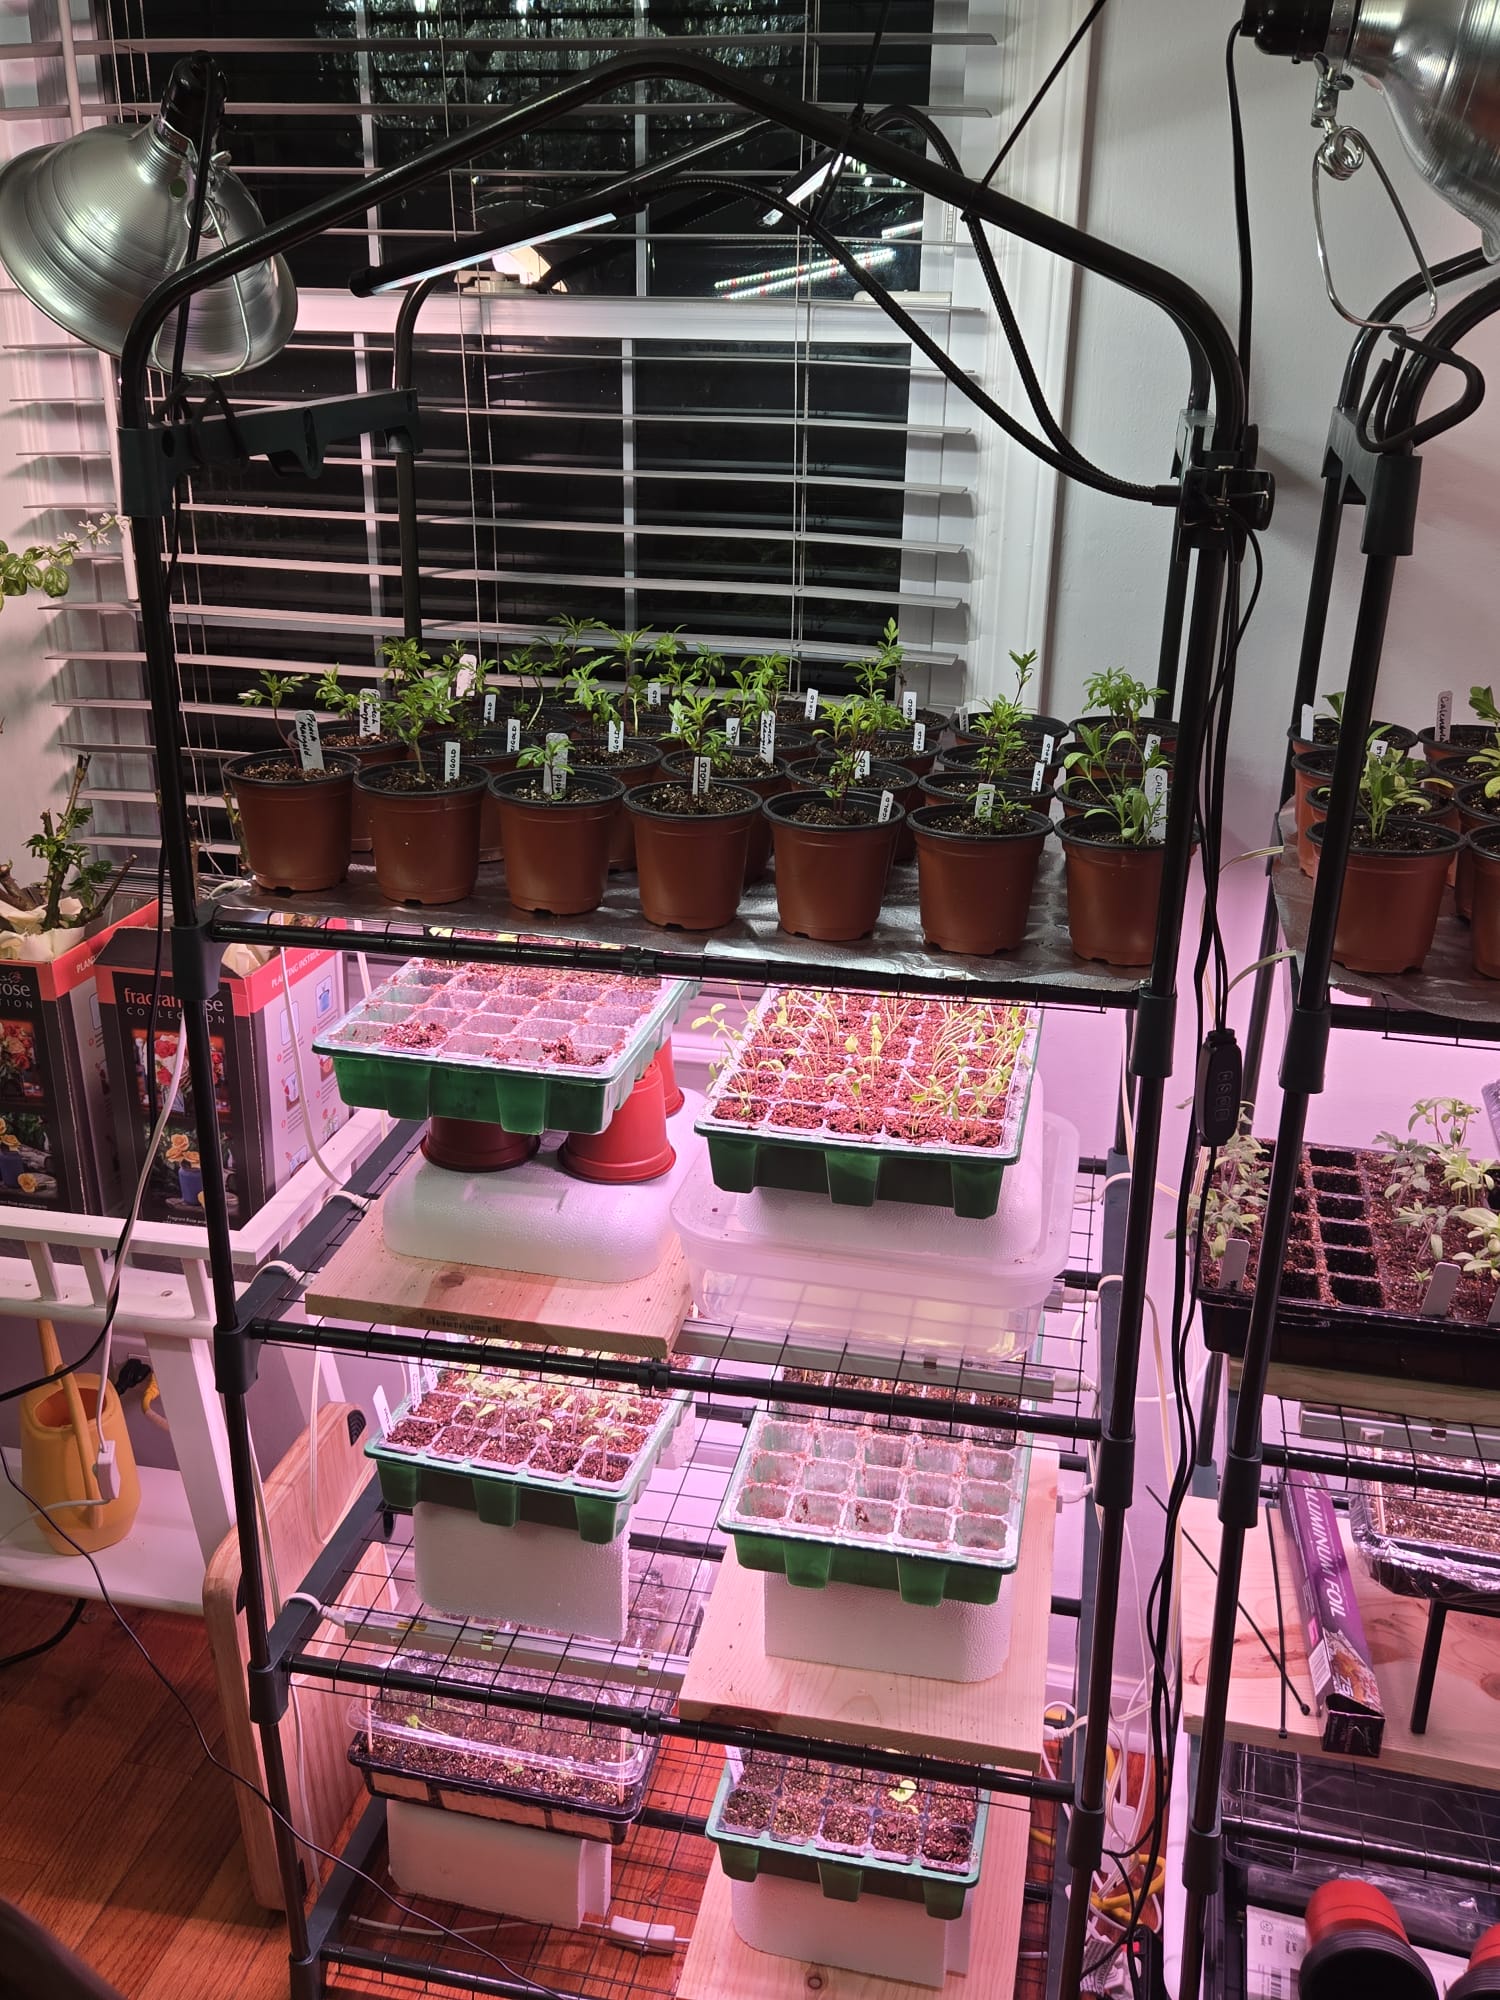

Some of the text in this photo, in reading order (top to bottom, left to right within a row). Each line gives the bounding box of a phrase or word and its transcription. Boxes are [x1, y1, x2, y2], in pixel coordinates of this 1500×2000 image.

[0, 982, 32, 998] ose
[1302, 1480, 1337, 1577] ALUMINUM
[1324, 1577, 1347, 1617] FOIL
